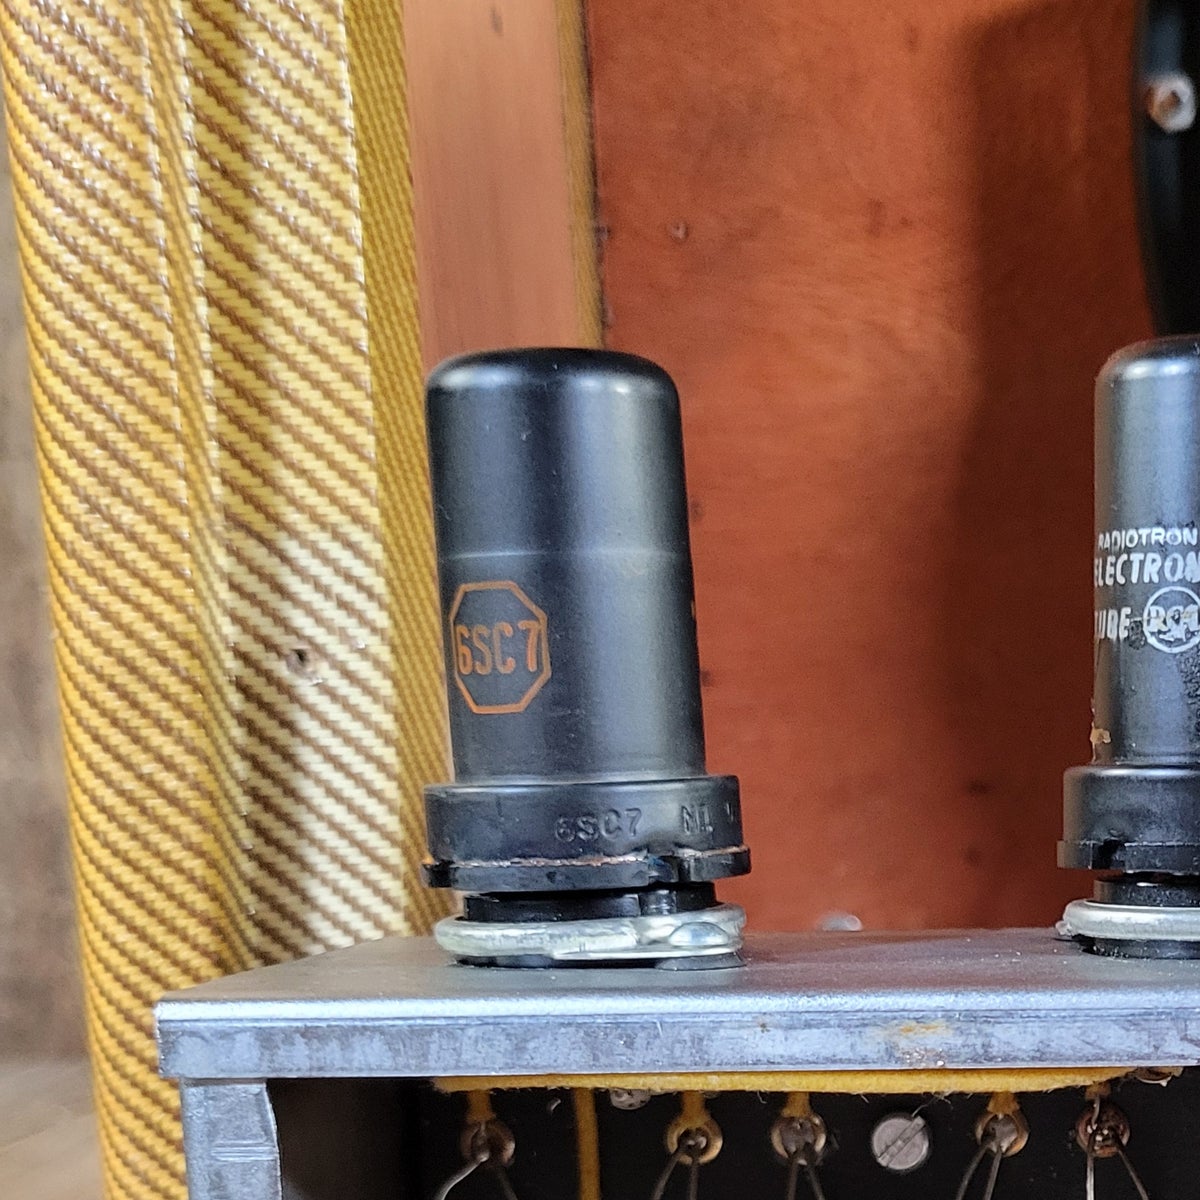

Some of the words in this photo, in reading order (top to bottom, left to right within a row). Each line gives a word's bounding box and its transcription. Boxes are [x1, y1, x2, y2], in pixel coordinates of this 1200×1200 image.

[1097, 526, 1198, 551] RADIOTRON
[456, 620, 541, 675] 6SC7
[555, 808, 642, 842] 6SC7
